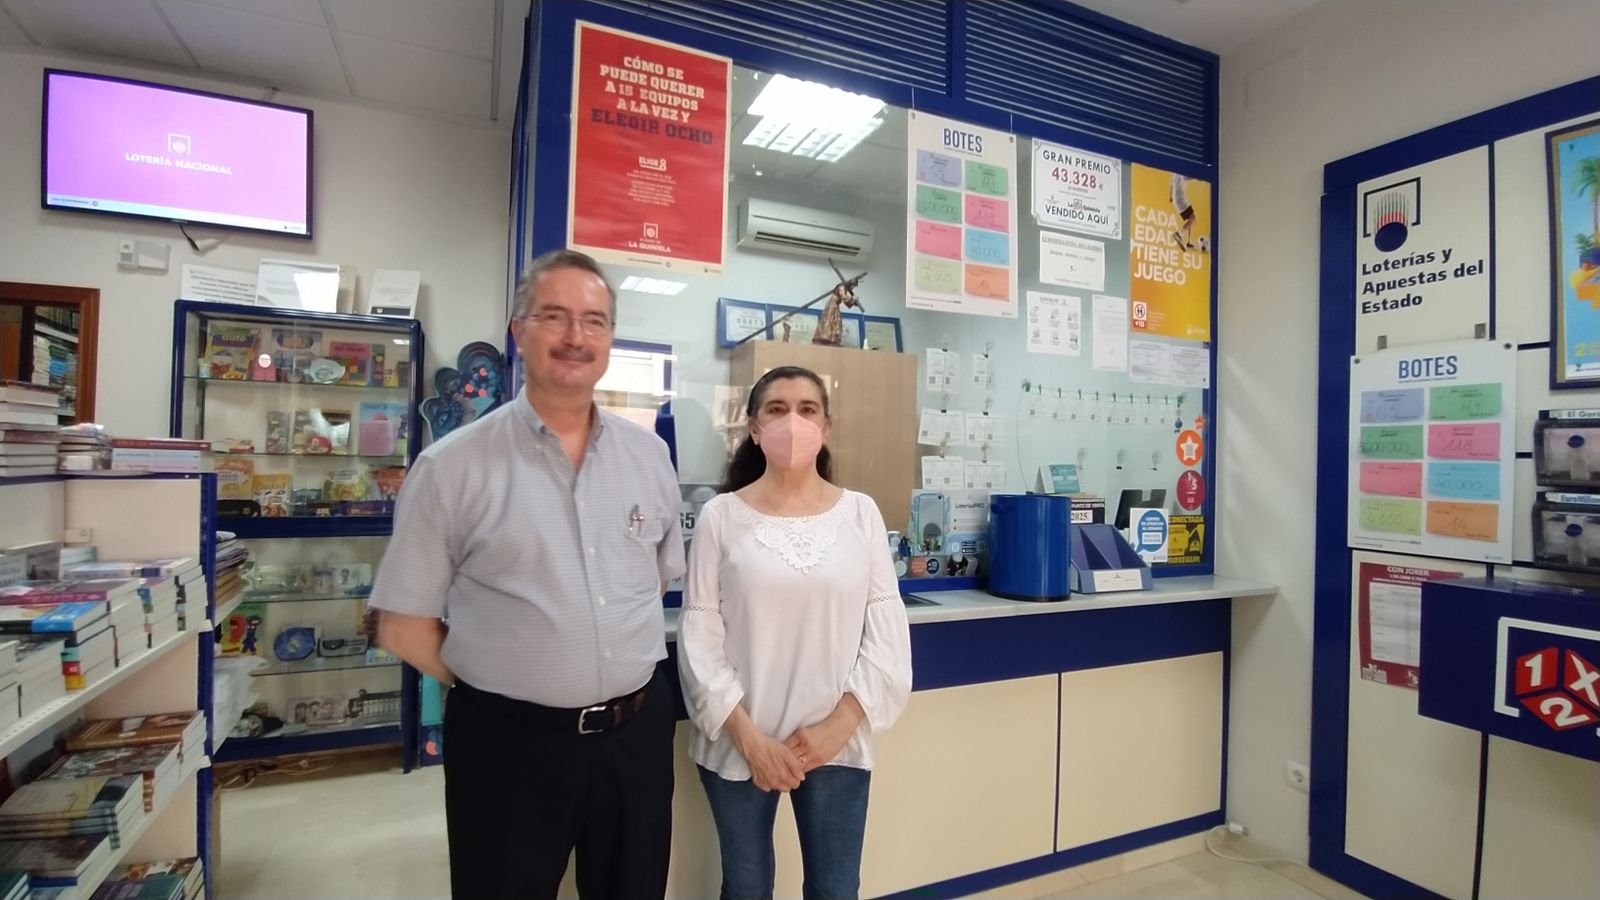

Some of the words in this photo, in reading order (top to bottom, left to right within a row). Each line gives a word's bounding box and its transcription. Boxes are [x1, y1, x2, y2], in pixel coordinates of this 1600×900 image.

[624, 56, 664, 75] CÓMO
[667, 67, 684, 80] SE
[600, 64, 648, 86] PUEDE
[651, 77, 705, 99] QUERER
[605, 81, 616, 93] A
[619, 84, 633, 96] 15
[640, 88, 699, 111] EQUIPOS
[617, 98, 628, 111] A
[630, 100, 649, 116] LA
[652, 104, 679, 121] VEZ
[681, 111, 691, 123] Y
[591, 108, 660, 135] ELEGIR
[665, 122, 713, 145] OCHO
[943, 127, 983, 153] BOTES
[175, 160, 233, 175] NACIONAL
[1043, 150, 1073, 166] GRAN
[1075, 157, 1111, 175] PREMIO
[1051, 166, 1097, 189] 43.328
[1045, 204, 1085, 221] VENDIDO
[1135, 205, 1178, 229] CADA
[1134, 223, 1178, 247] EDAD
[1133, 242, 1180, 266] TIENE
[1183, 252, 1203, 270] SU
[1361, 249, 1436, 276] Loterías
[1441, 247, 1453, 263] y
[1133, 261, 1187, 286] JUEGO
[1362, 267, 1448, 296] Apuestas
[1453, 259, 1485, 279] del
[1361, 292, 1424, 315] Estado
[1398, 355, 1458, 379] BOTES
[1387, 565, 1404, 574] CON
[1524, 653, 1543, 687] 1
[1540, 697, 1590, 727] 2
